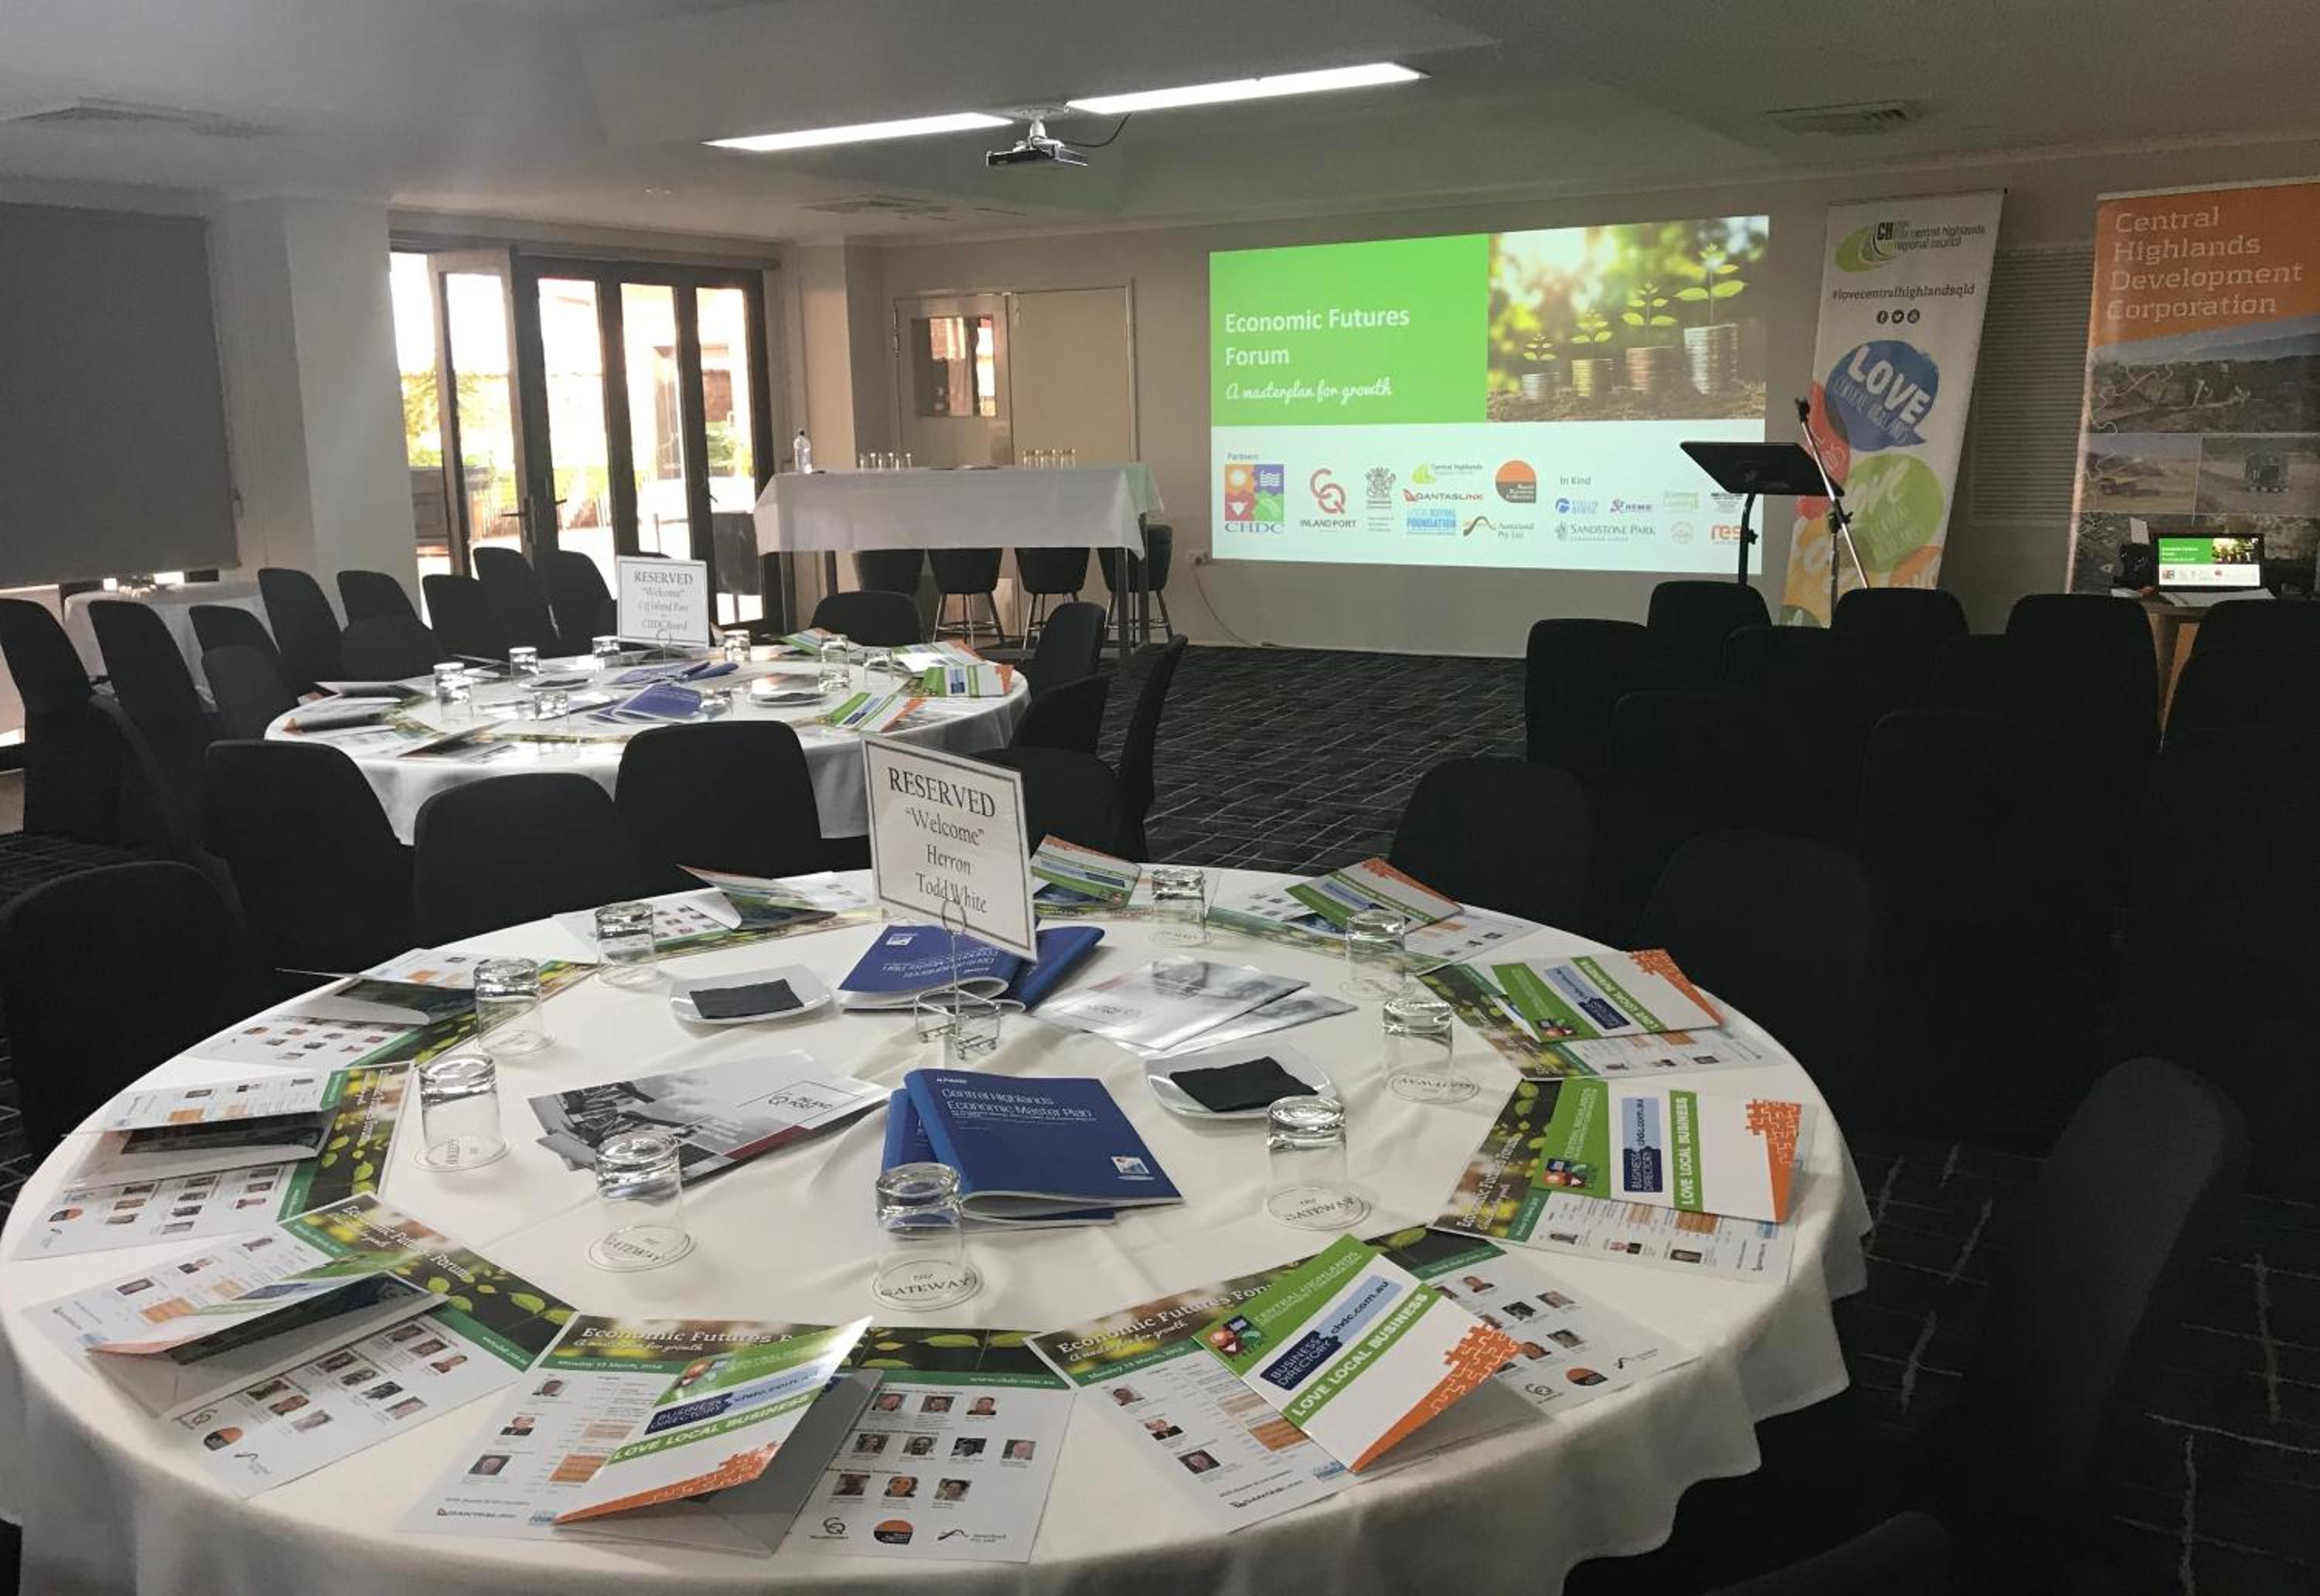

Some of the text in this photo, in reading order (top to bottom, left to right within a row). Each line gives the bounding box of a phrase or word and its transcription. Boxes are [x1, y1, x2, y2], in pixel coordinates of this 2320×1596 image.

[2115, 206, 2219, 234] Central
[2113, 234, 2260, 266] Highlands
[2110, 261, 2302, 293] Development
[1226, 309, 1410, 332] Economic Futures
[2107, 294, 2276, 323] Corporation
[1225, 347, 1289, 366] Forum
[1226, 377, 1393, 405] A masterplan for growth
[1847, 345, 1931, 425] LOVE
[1224, 522, 1285, 534] CHDC
[1300, 520, 1332, 528] INLAND
[634, 571, 694, 585] RESERVED
[888, 766, 996, 817] RESERVED
[926, 844, 971, 875] Herron
[916, 871, 988, 914] Todd White
[941, 1088, 1054, 1105] Central Highlands
[947, 1100, 1092, 1118] Economic Master Plan
[1674, 1096, 1694, 1205] LOVE LOCAL BUSINESS
[880, 1277, 970, 1297] GATEWAY
[1330, 1280, 1389, 1335] chdc.com.au
[582, 1327, 687, 1342] Economic
[691, 1331, 773, 1344] Futures
[1056, 1317, 1157, 1355] Economic
[1158, 1295, 1231, 1324] Futures
[1270, 1337, 1322, 1379] BUSINESS
[1277, 1339, 1332, 1386] DIRECTORY
[1291, 1293, 1429, 1417] LOVE LOCAL BUSINESS
[614, 1393, 812, 1461] LOVE LOCAL BUSINESS
